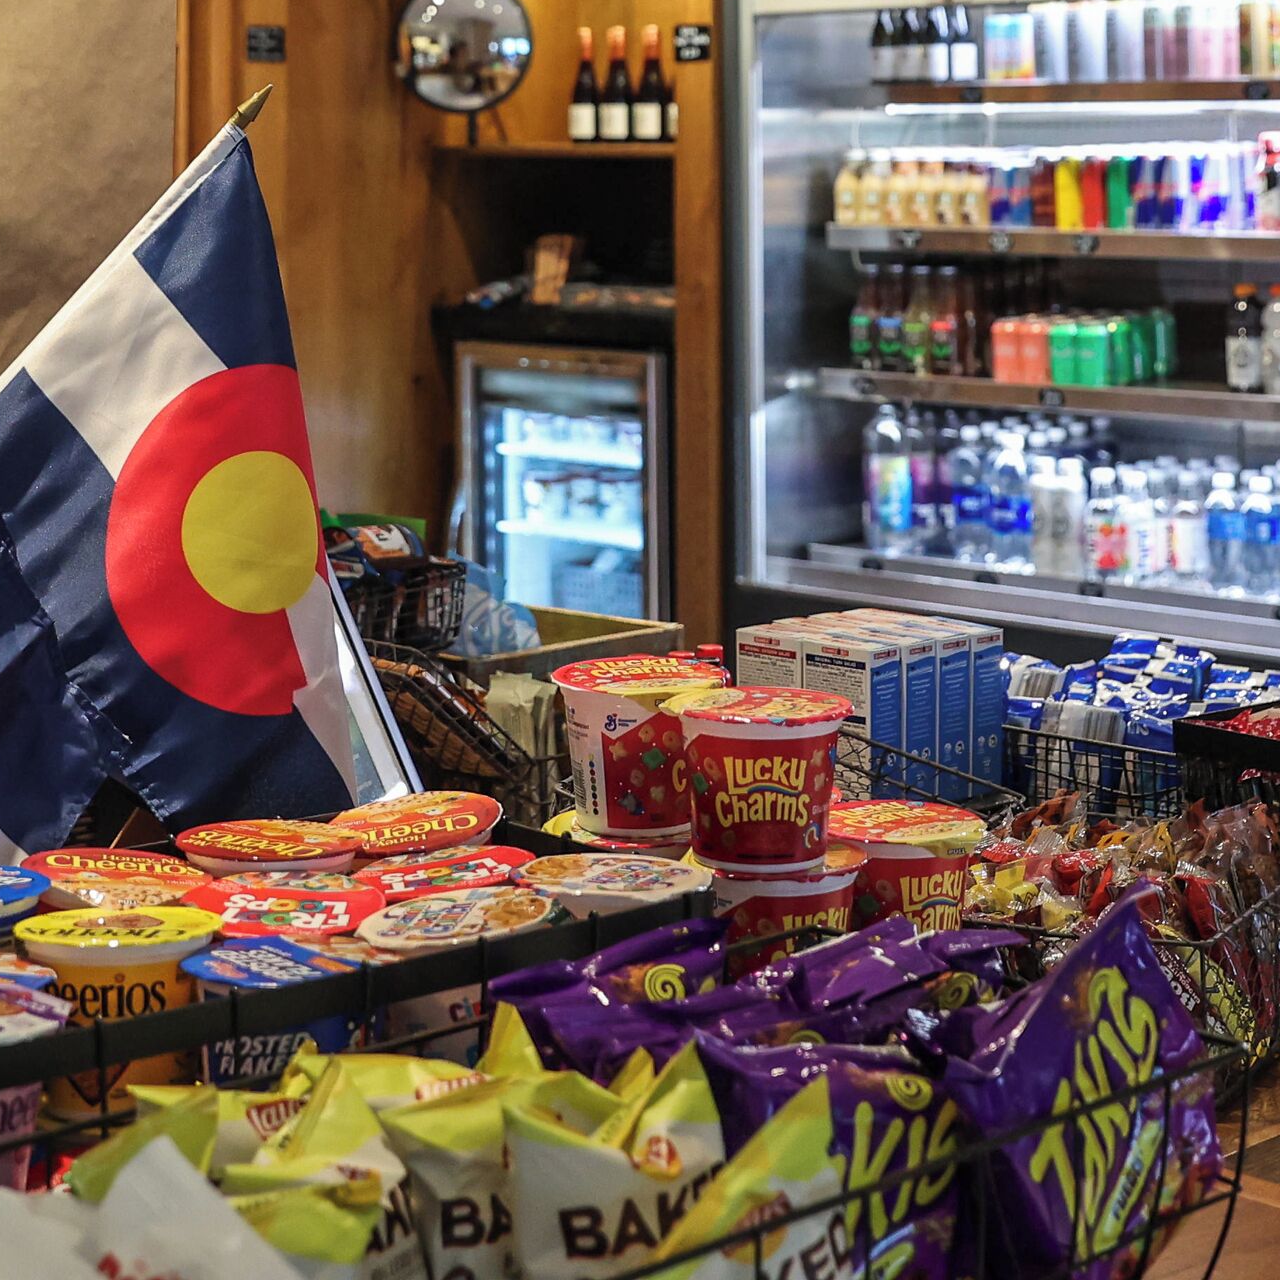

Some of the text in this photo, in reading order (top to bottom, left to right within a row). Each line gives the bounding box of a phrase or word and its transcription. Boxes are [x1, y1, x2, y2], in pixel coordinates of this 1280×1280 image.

[723, 756, 808, 796] Lucky
[715, 790, 811, 827] Charms
[190, 831, 324, 857] Cheerios
[45, 854, 206, 877] Cheerios
[223, 893, 349, 913] LOOPS
[899, 870, 964, 913] Lucky
[221, 908, 351, 929] FROOT
[904, 904, 963, 932] harms
[45, 973, 167, 1019] eerios
